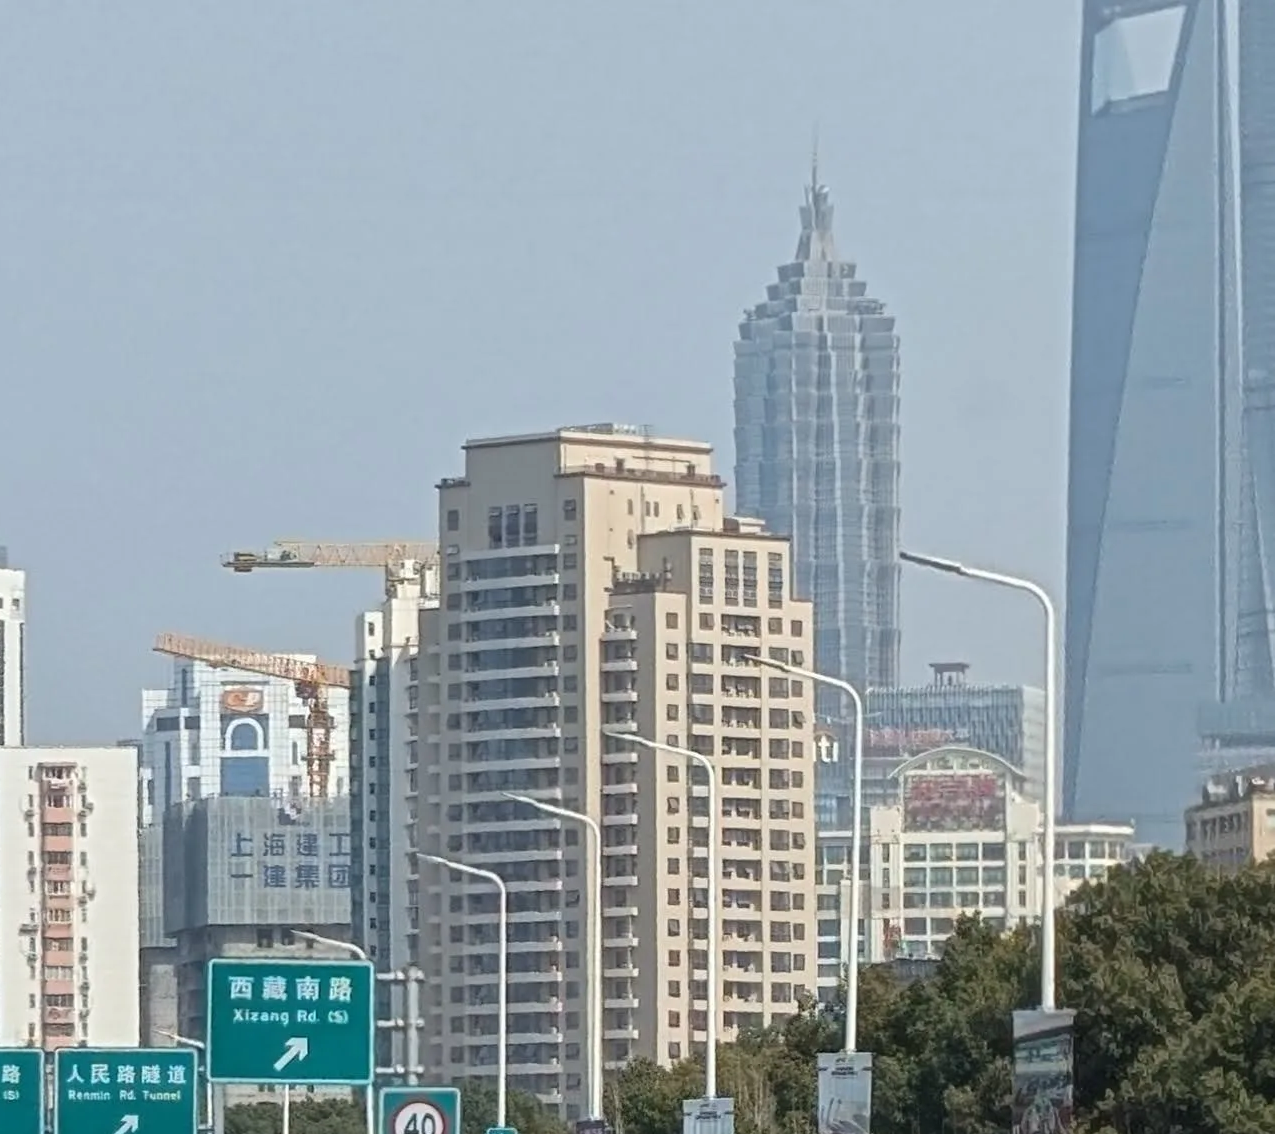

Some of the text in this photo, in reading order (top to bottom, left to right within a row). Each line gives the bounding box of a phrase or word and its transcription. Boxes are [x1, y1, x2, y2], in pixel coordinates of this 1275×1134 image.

[231, 833, 350, 857] 上海建工
[231, 864, 350, 889] 一建集团
[228, 976, 352, 1002] 西藏南路
[233, 1009, 289, 1026] Xizang
[297, 1010, 320, 1022] Rd.
[67, 1063, 186, 1085] 人民路隧道
[68, 1089, 181, 1101] Renmin Rd. Tunnel
